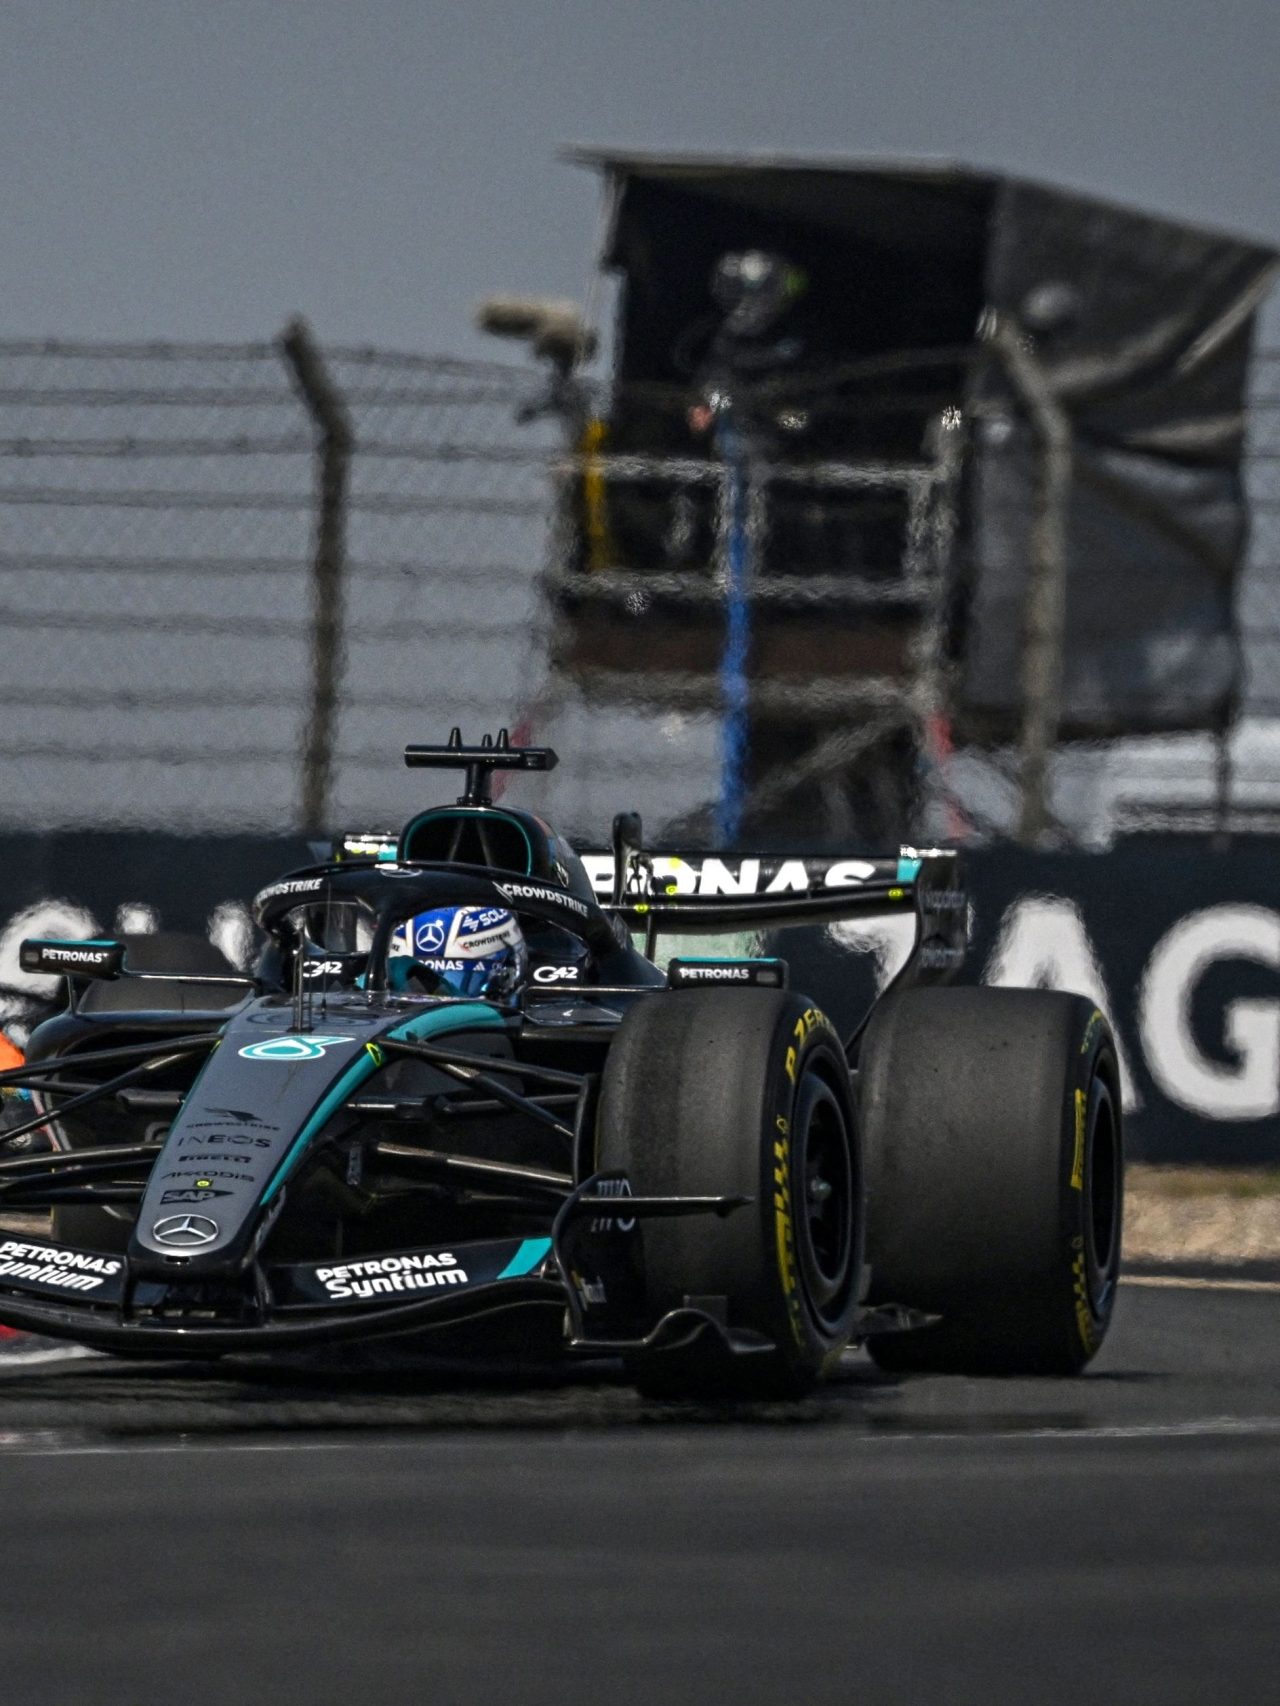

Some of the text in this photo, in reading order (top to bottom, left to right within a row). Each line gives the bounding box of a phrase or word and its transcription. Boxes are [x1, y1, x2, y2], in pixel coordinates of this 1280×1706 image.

[502, 883, 589, 918] CROWDSTRIKE
[41, 948, 104, 963] PETRONAS
[419, 960, 464, 971] ONAS
[680, 967, 750, 980] PETRONAS
[533, 966, 578, 983] G42
[177, 1134, 272, 1148] INEOS
[315, 1252, 458, 1283] PETRONAS
[325, 1269, 469, 1300] Syntium
